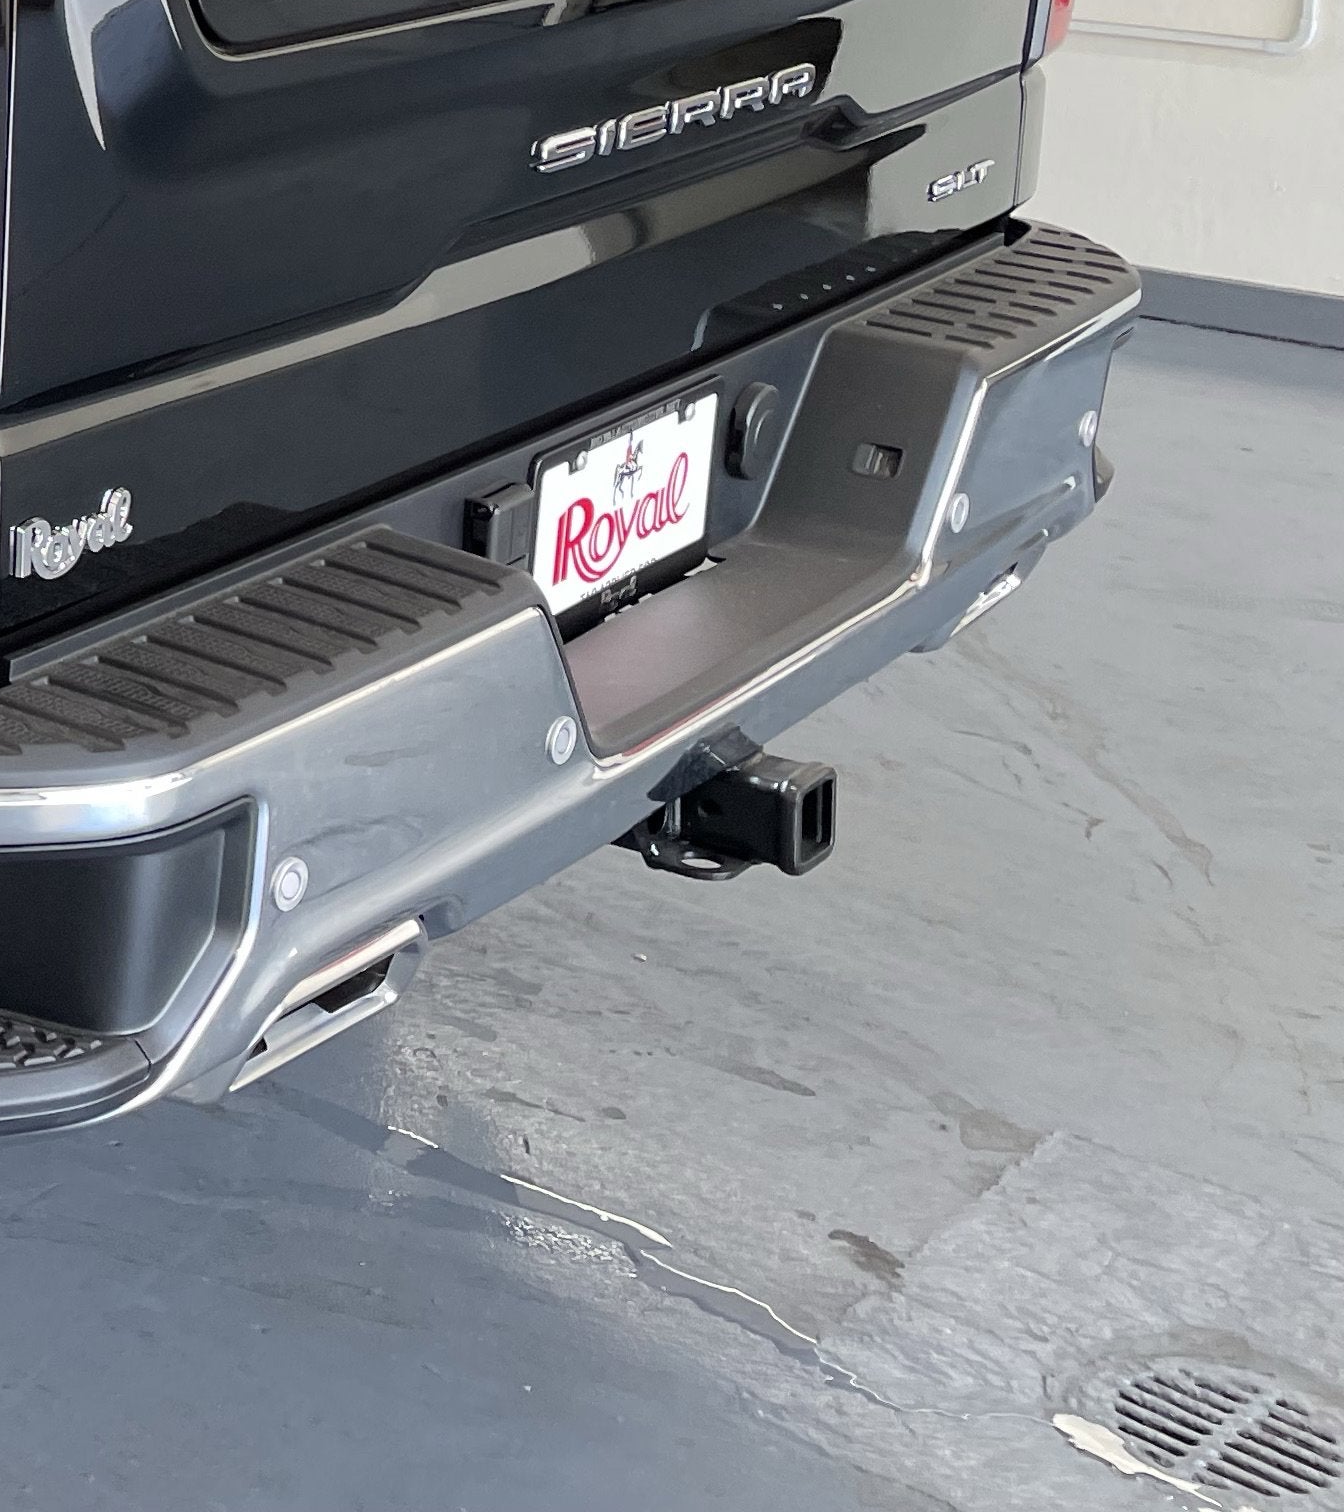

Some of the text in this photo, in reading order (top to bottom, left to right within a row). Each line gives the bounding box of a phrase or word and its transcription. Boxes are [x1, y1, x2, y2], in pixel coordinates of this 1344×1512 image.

[527, 62, 817, 173] SIERRA
[926, 159, 996, 202] SLT
[9, 487, 134, 580] Royal
[552, 452, 691, 586] Royal
